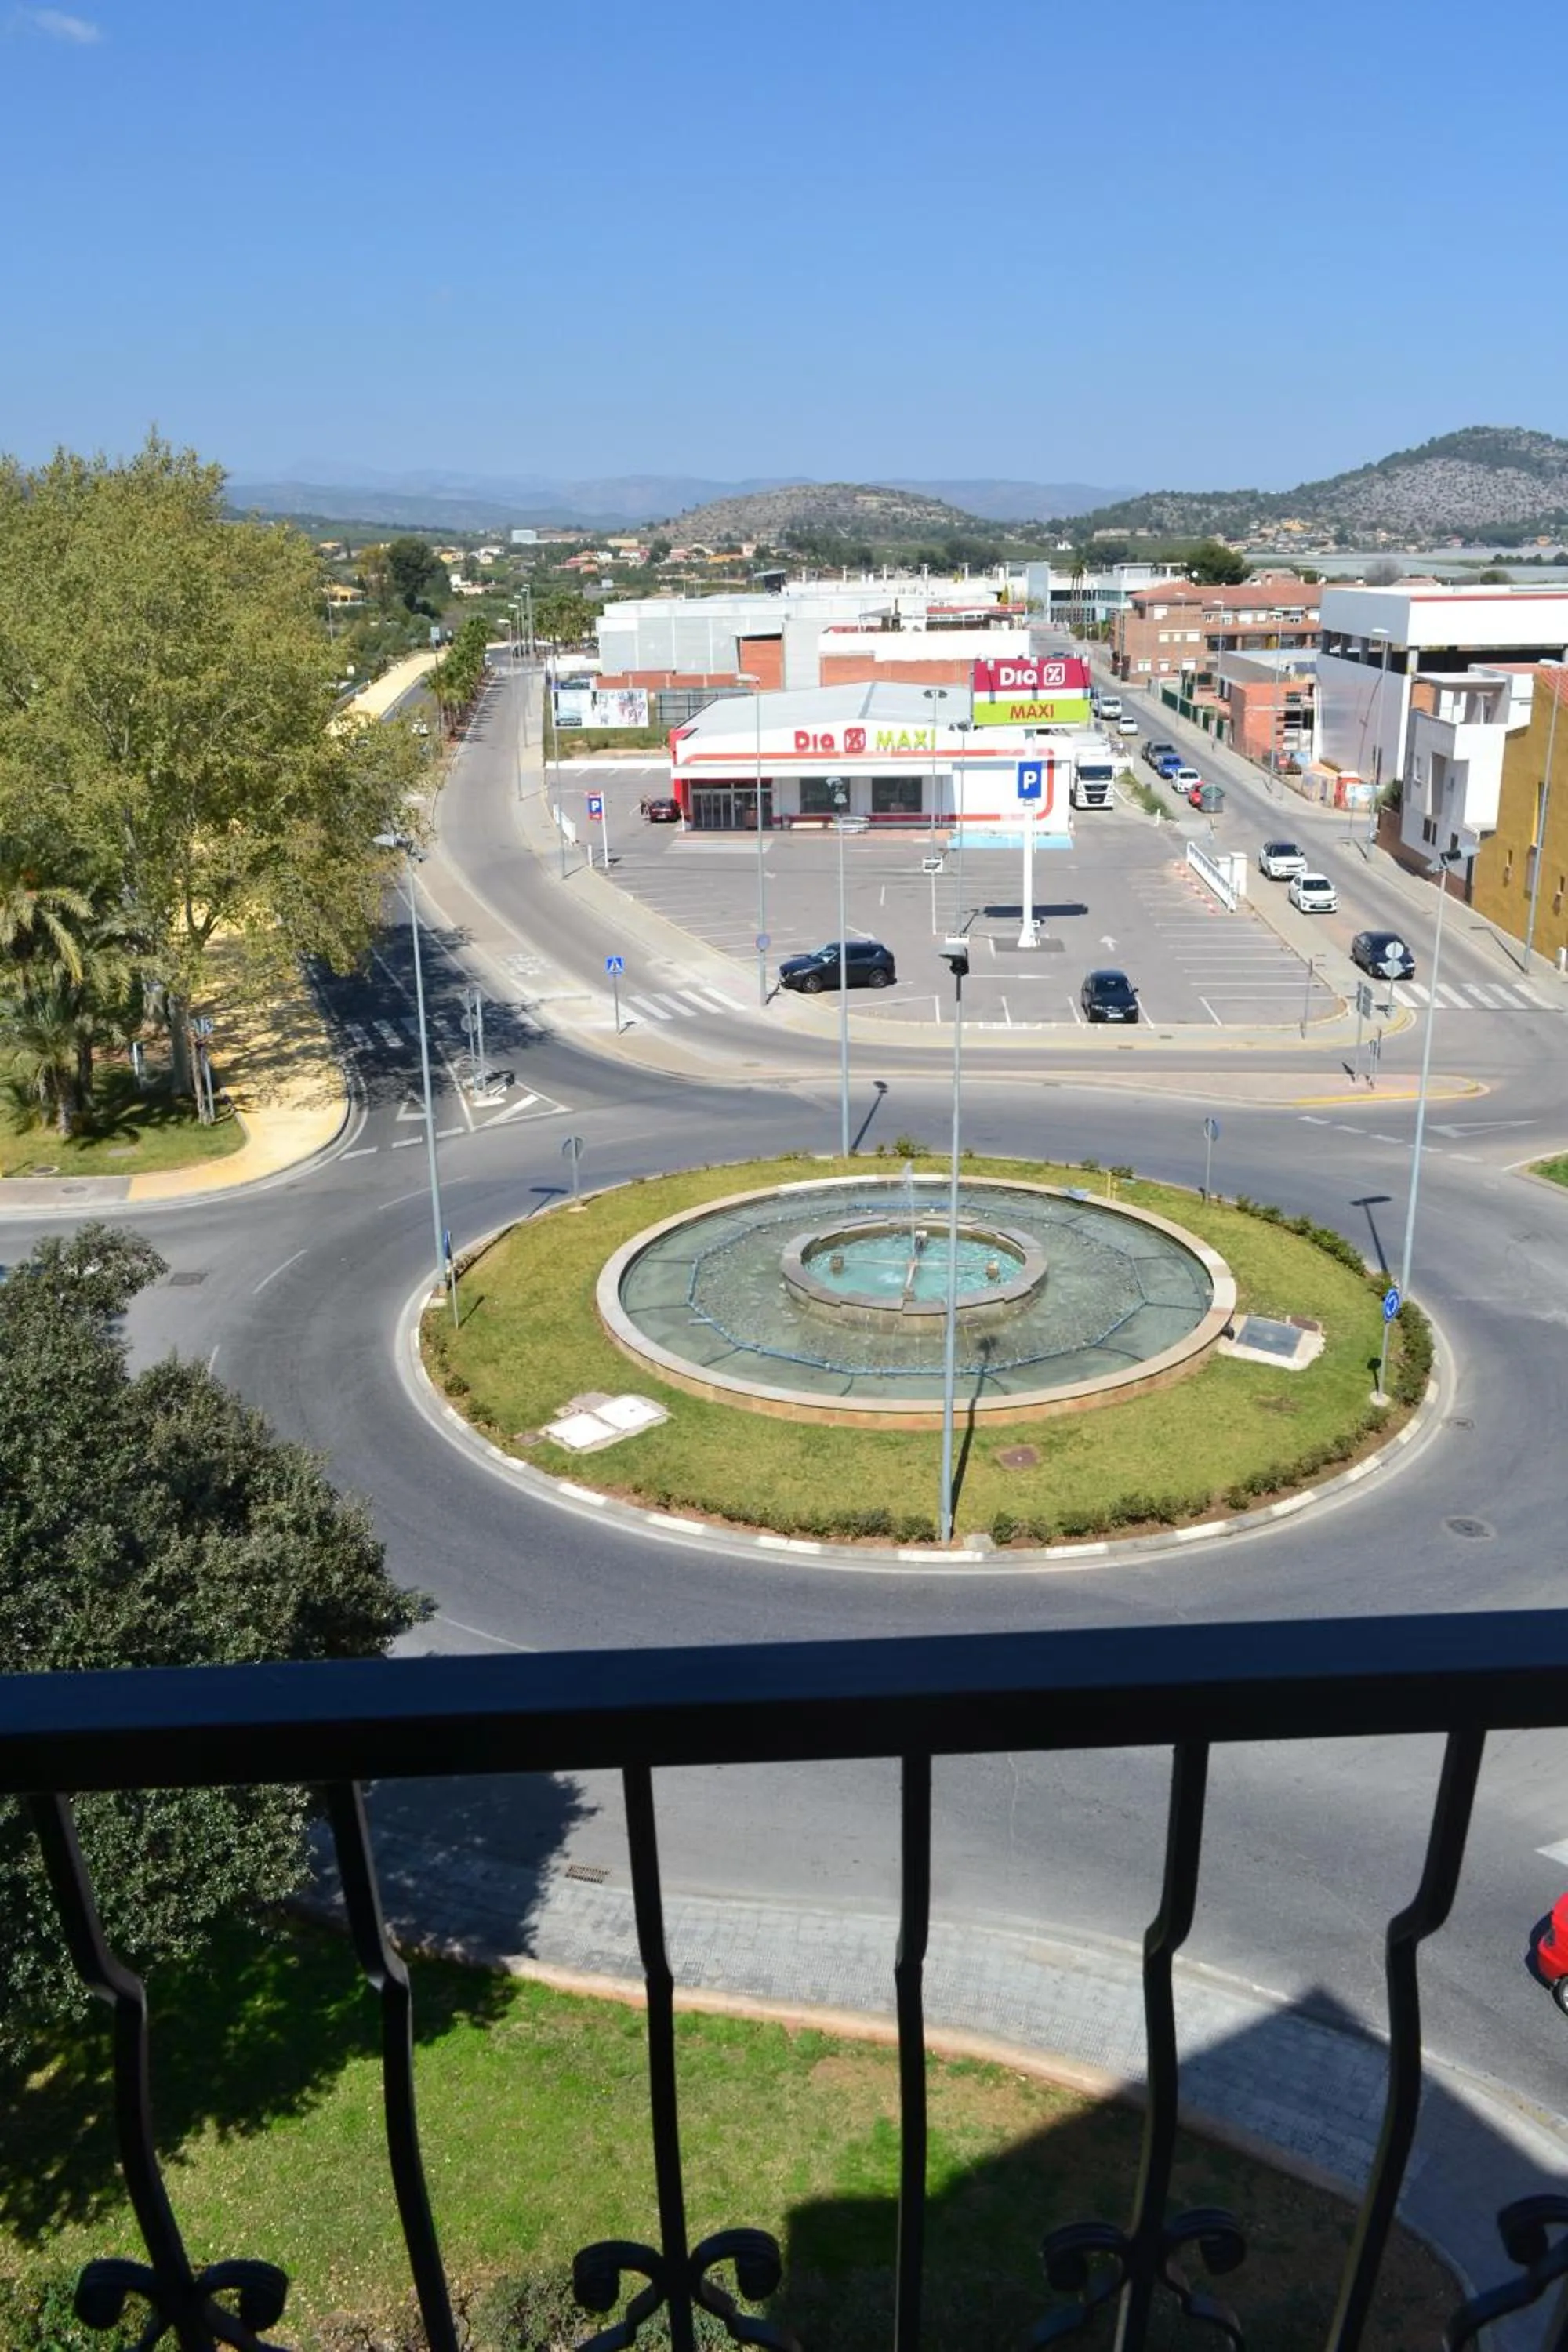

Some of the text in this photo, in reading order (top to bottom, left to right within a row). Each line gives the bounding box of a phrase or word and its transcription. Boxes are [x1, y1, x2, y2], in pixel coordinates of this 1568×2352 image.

[1010, 704, 1054, 720] MAXI
[875, 729, 936, 750] MAXI
[1023, 771, 1037, 791] P
[591, 800, 600, 812] P
